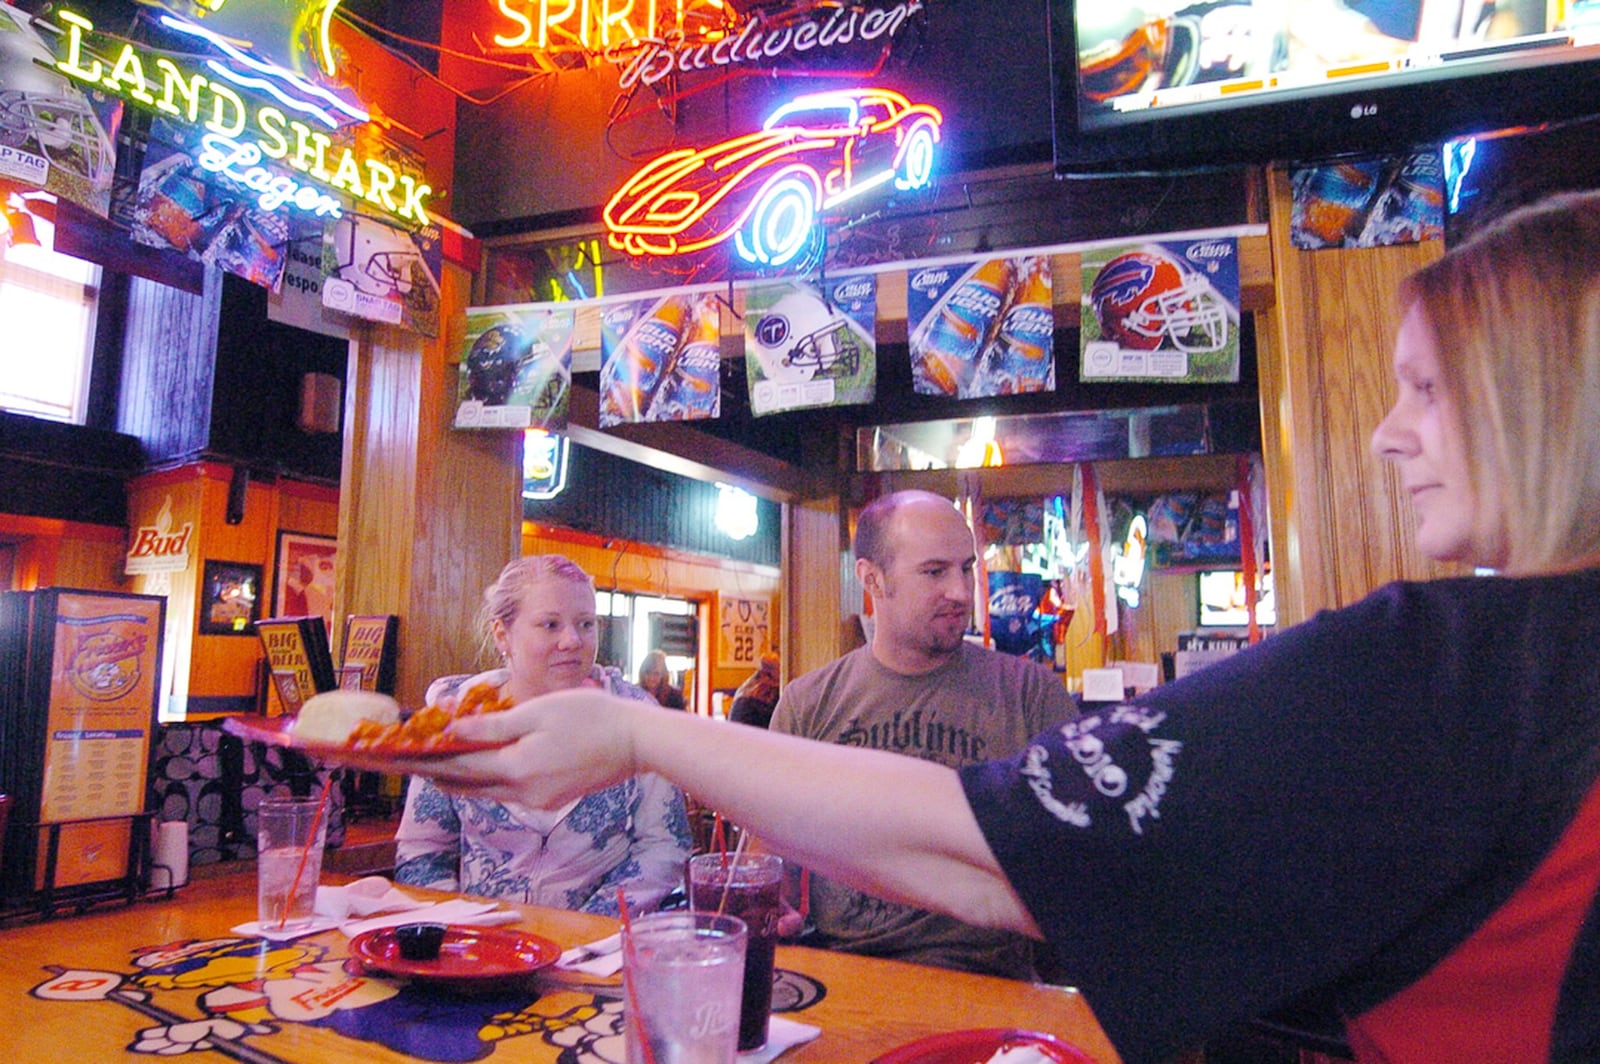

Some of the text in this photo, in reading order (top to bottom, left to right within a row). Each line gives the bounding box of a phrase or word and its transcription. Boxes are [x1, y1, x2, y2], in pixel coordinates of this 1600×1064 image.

[493, 0, 723, 48] SPIRI
[604, 1, 923, 89] Budweiser
[1363, 104, 1378, 116] LG
[16, 151, 46, 169] TAG
[199, 132, 343, 218] Lager
[282, 270, 320, 294] respo
[128, 525, 191, 558] Bud
[269, 631, 298, 651] BIG
[354, 626, 385, 644] BIG
[734, 636, 755, 662] 22
